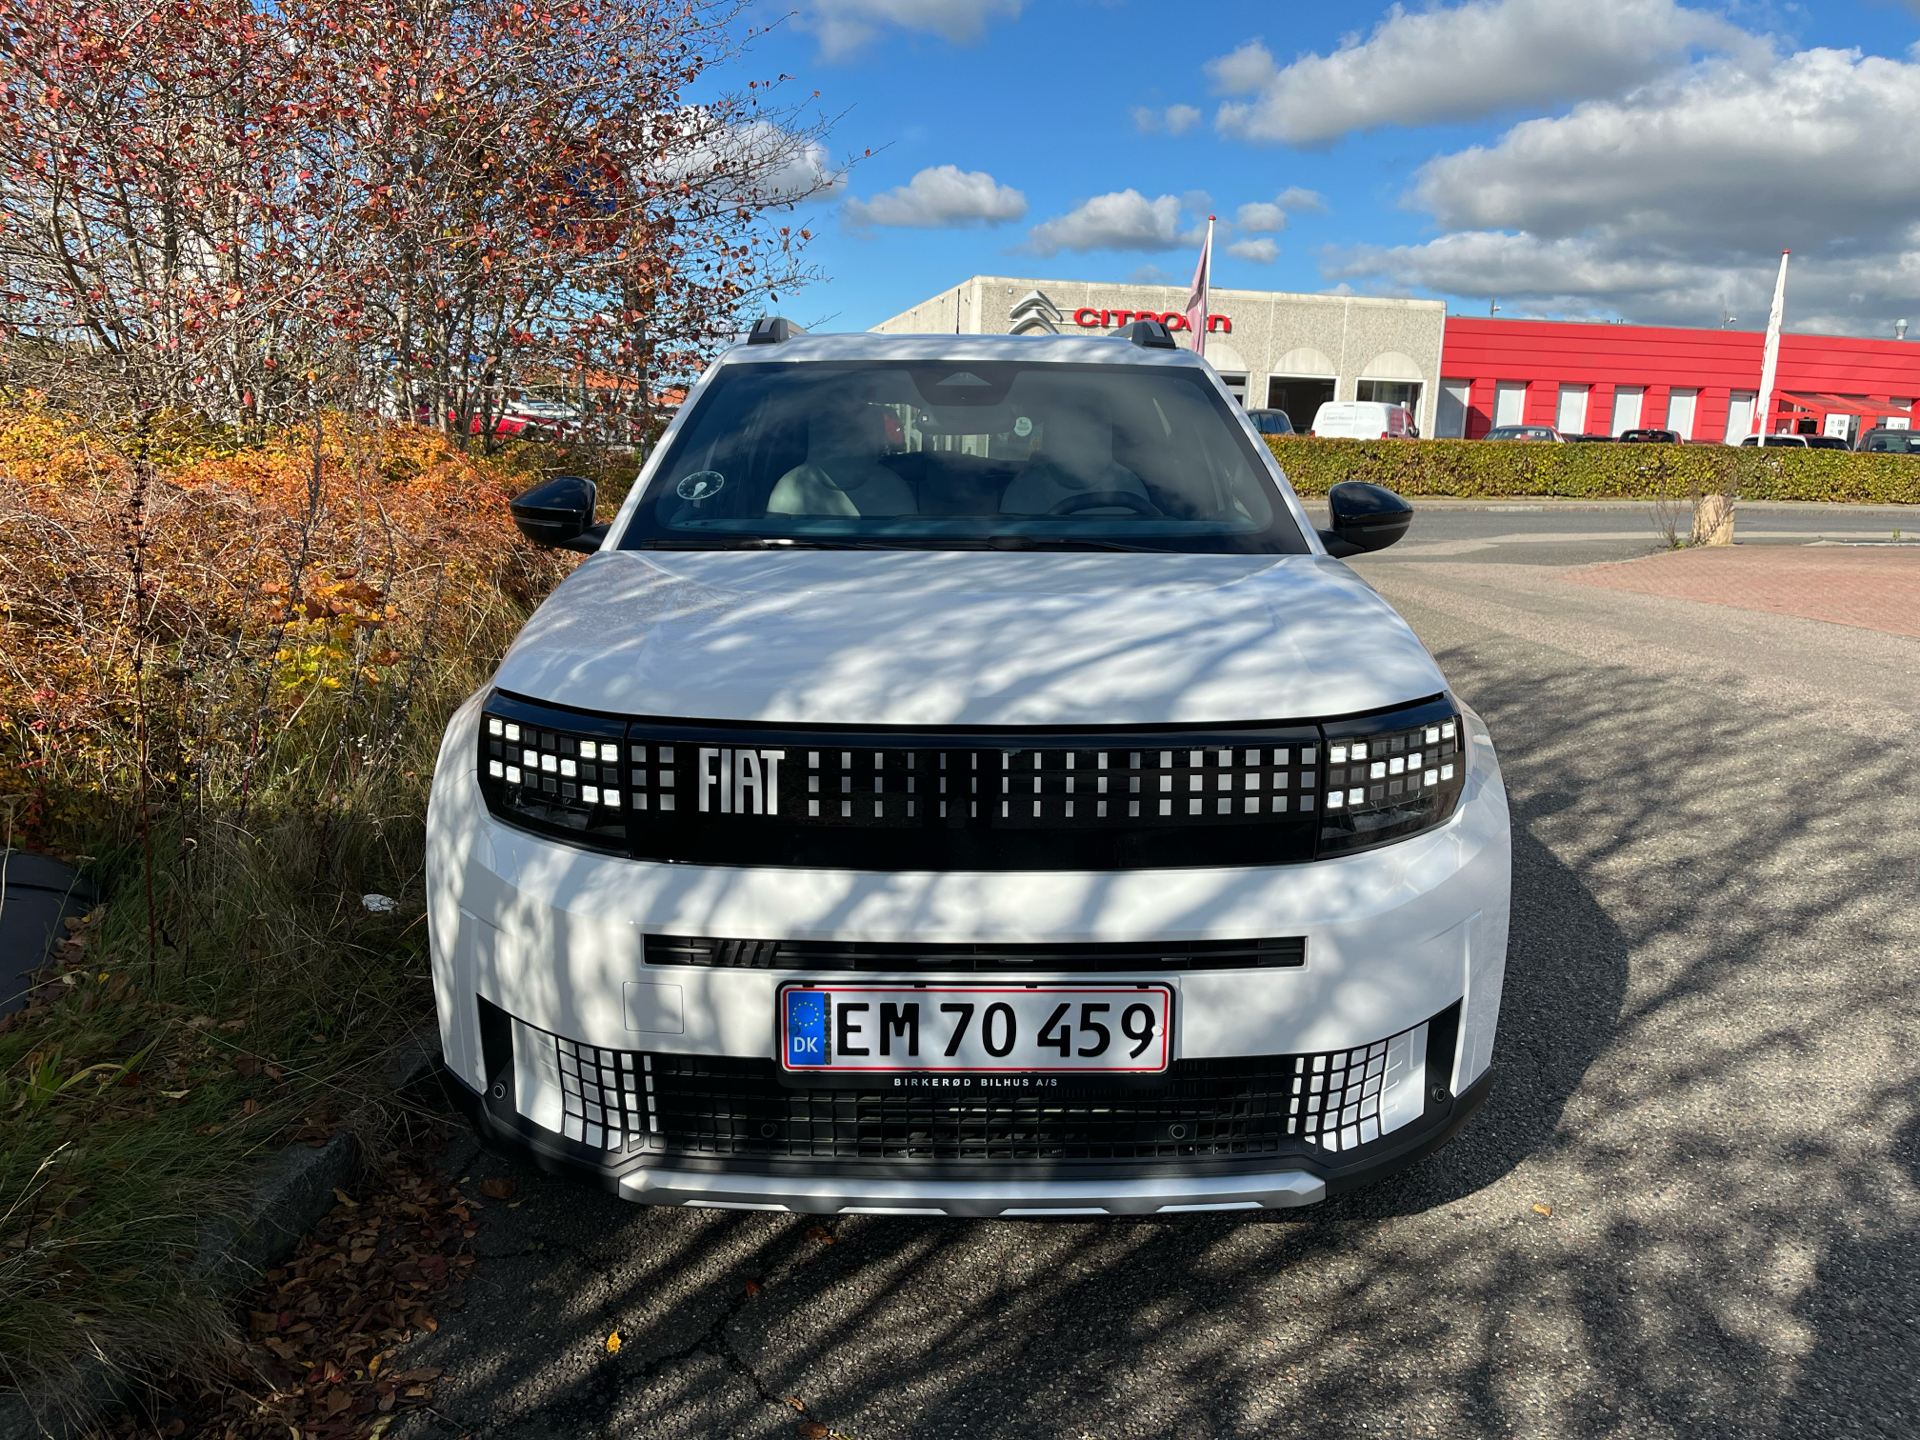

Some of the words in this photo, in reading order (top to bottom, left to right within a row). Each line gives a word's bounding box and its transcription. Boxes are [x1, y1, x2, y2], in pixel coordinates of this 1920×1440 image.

[699, 747, 786, 815] FIAT
[793, 1036, 819, 1053] DK
[837, 1002, 920, 1056] EM
[940, 1002, 1017, 1058] 70
[1036, 1002, 1157, 1059] 459
[893, 1078, 972, 1087] BIRKERØD
[980, 1078, 1030, 1087] BILHUS
[1035, 1078, 1058, 1087] A/S
